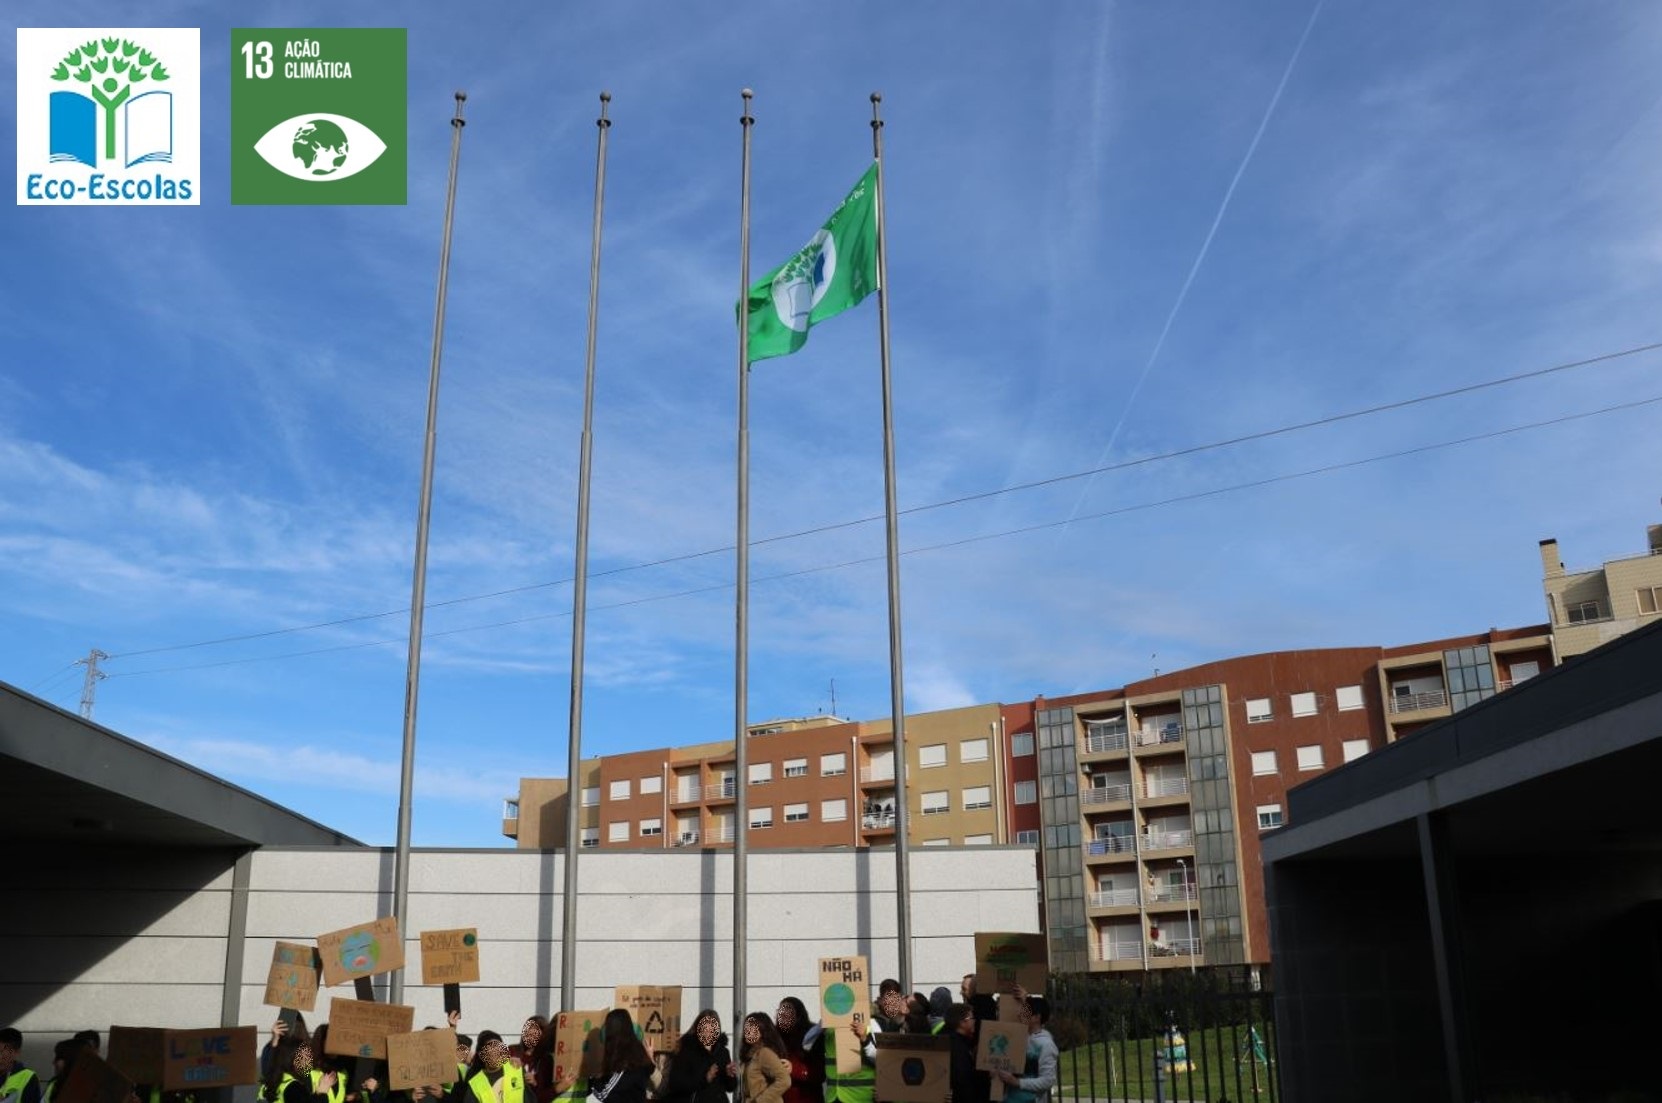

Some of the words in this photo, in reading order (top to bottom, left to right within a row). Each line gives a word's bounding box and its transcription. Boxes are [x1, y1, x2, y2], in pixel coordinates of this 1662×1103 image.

[427, 933, 460, 950] SAVE
[822, 957, 852, 972] NÃO
[842, 967, 863, 983] HÁ
[559, 1015, 567, 1029] R
[170, 1036, 231, 1059] LOVE
[557, 1040, 565, 1055] R
[555, 1065, 563, 1080] R
